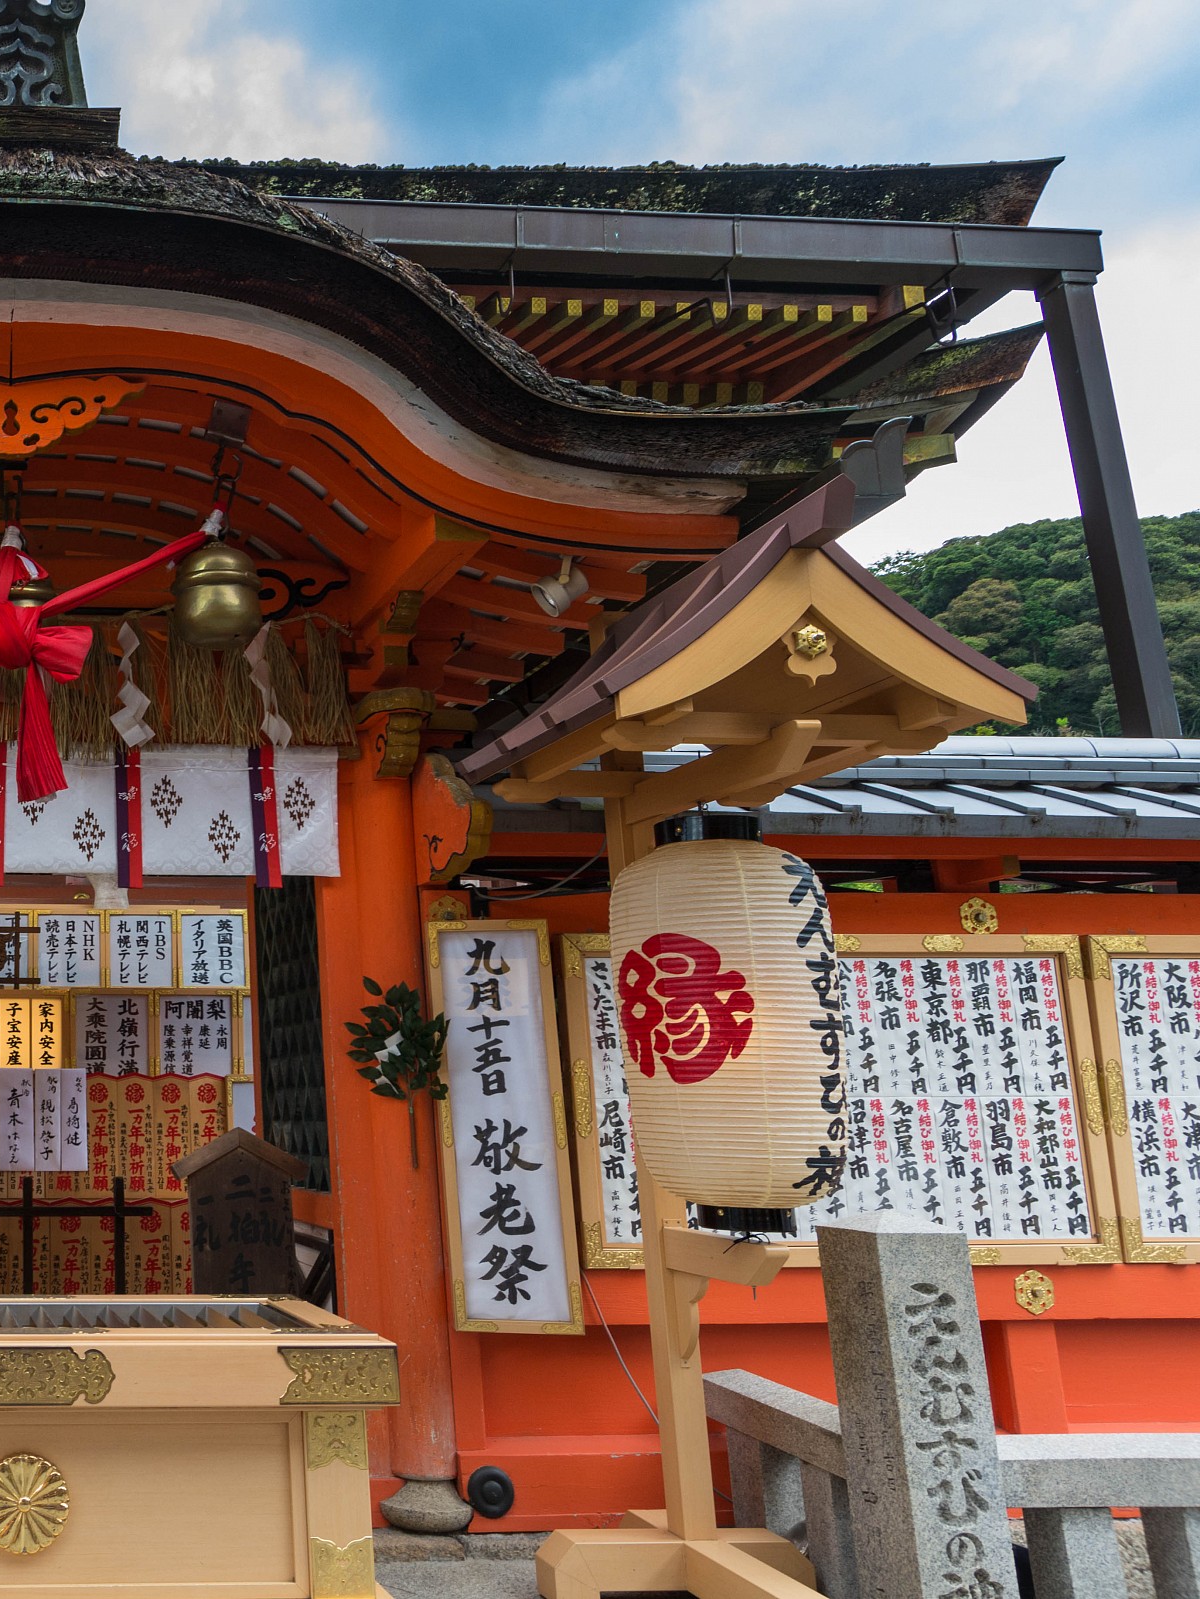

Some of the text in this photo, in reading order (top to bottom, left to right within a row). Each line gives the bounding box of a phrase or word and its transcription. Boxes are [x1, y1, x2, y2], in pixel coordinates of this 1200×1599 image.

[45, 919, 60, 983] 読売テレビ
[64, 920, 78, 983] 日本テレビ
[83, 920, 95, 961] NHK
[116, 920, 132, 984] 札幌テレビ
[136, 920, 150, 984] 関西テレビ
[154, 920, 167, 961] TBS
[190, 919, 210, 984] イタリア放送
[216, 919, 234, 984] 英国BBC
[164, 999, 227, 1021] 阿闍梨
[591, 960, 617, 1050] さいたま市
[618, 933, 755, 1084] 縁
[852, 959, 872, 1023] 縁結び御礼
[872, 960, 904, 1031] 名張市
[899, 959, 920, 1023] 縁結び御礼
[920, 959, 952, 1044] 東京都
[946, 959, 967, 1023] 縁結び御礼
[965, 959, 996, 1038] 那覇市
[992, 959, 1014, 1023] 縁結び御礼
[1012, 960, 1042, 1032] 福岡市
[1038, 959, 1060, 1022] 縁結び御礼
[1117, 963, 1146, 1037] 所沢市
[1142, 961, 1162, 1024] 縁結び御礼
[1163, 961, 1193, 1035] 大阪市
[5, 1002, 23, 1066] 子宝安産
[38, 1002, 56, 1066] 家内安全
[198, 1023, 211, 1050] 康延
[216, 1023, 228, 1050] 永周
[858, 1026, 880, 1094] 五千円
[906, 1029, 928, 1096] 五千円
[951, 1026, 977, 1095] 五千円
[998, 1026, 1022, 1094] 五千円
[1045, 1025, 1070, 1092] 五千円
[1148, 1028, 1169, 1094] 五千円
[466, 938, 548, 1306] 九月十五日 敬老祭
[599, 1099, 628, 1180] 尼崎市
[869, 1098, 890, 1164] 縁結び御礼
[890, 1099, 919, 1181] 名古屋市
[916, 1098, 938, 1164] 縁結び御礼
[938, 1099, 969, 1180] 倉敷市
[963, 1098, 985, 1164] 縁結び御礼
[985, 1098, 1014, 1176] 羽島市
[1011, 1098, 1033, 1164] 縁結び御礼
[1031, 1098, 1064, 1191] 大和郡山市
[1058, 1097, 1079, 1163] 縁結び御礼
[1131, 1098, 1161, 1178] 横浜市
[1158, 1097, 1180, 1162] 縁結び御礼
[873, 1167, 893, 1211] 五千
[921, 1168, 944, 1225] 五千
[969, 1167, 993, 1238] 五千円
[1017, 1165, 1041, 1236] 五千円
[1064, 1165, 1089, 1236] 五千円
[1164, 1166, 1189, 1234] 五千円
